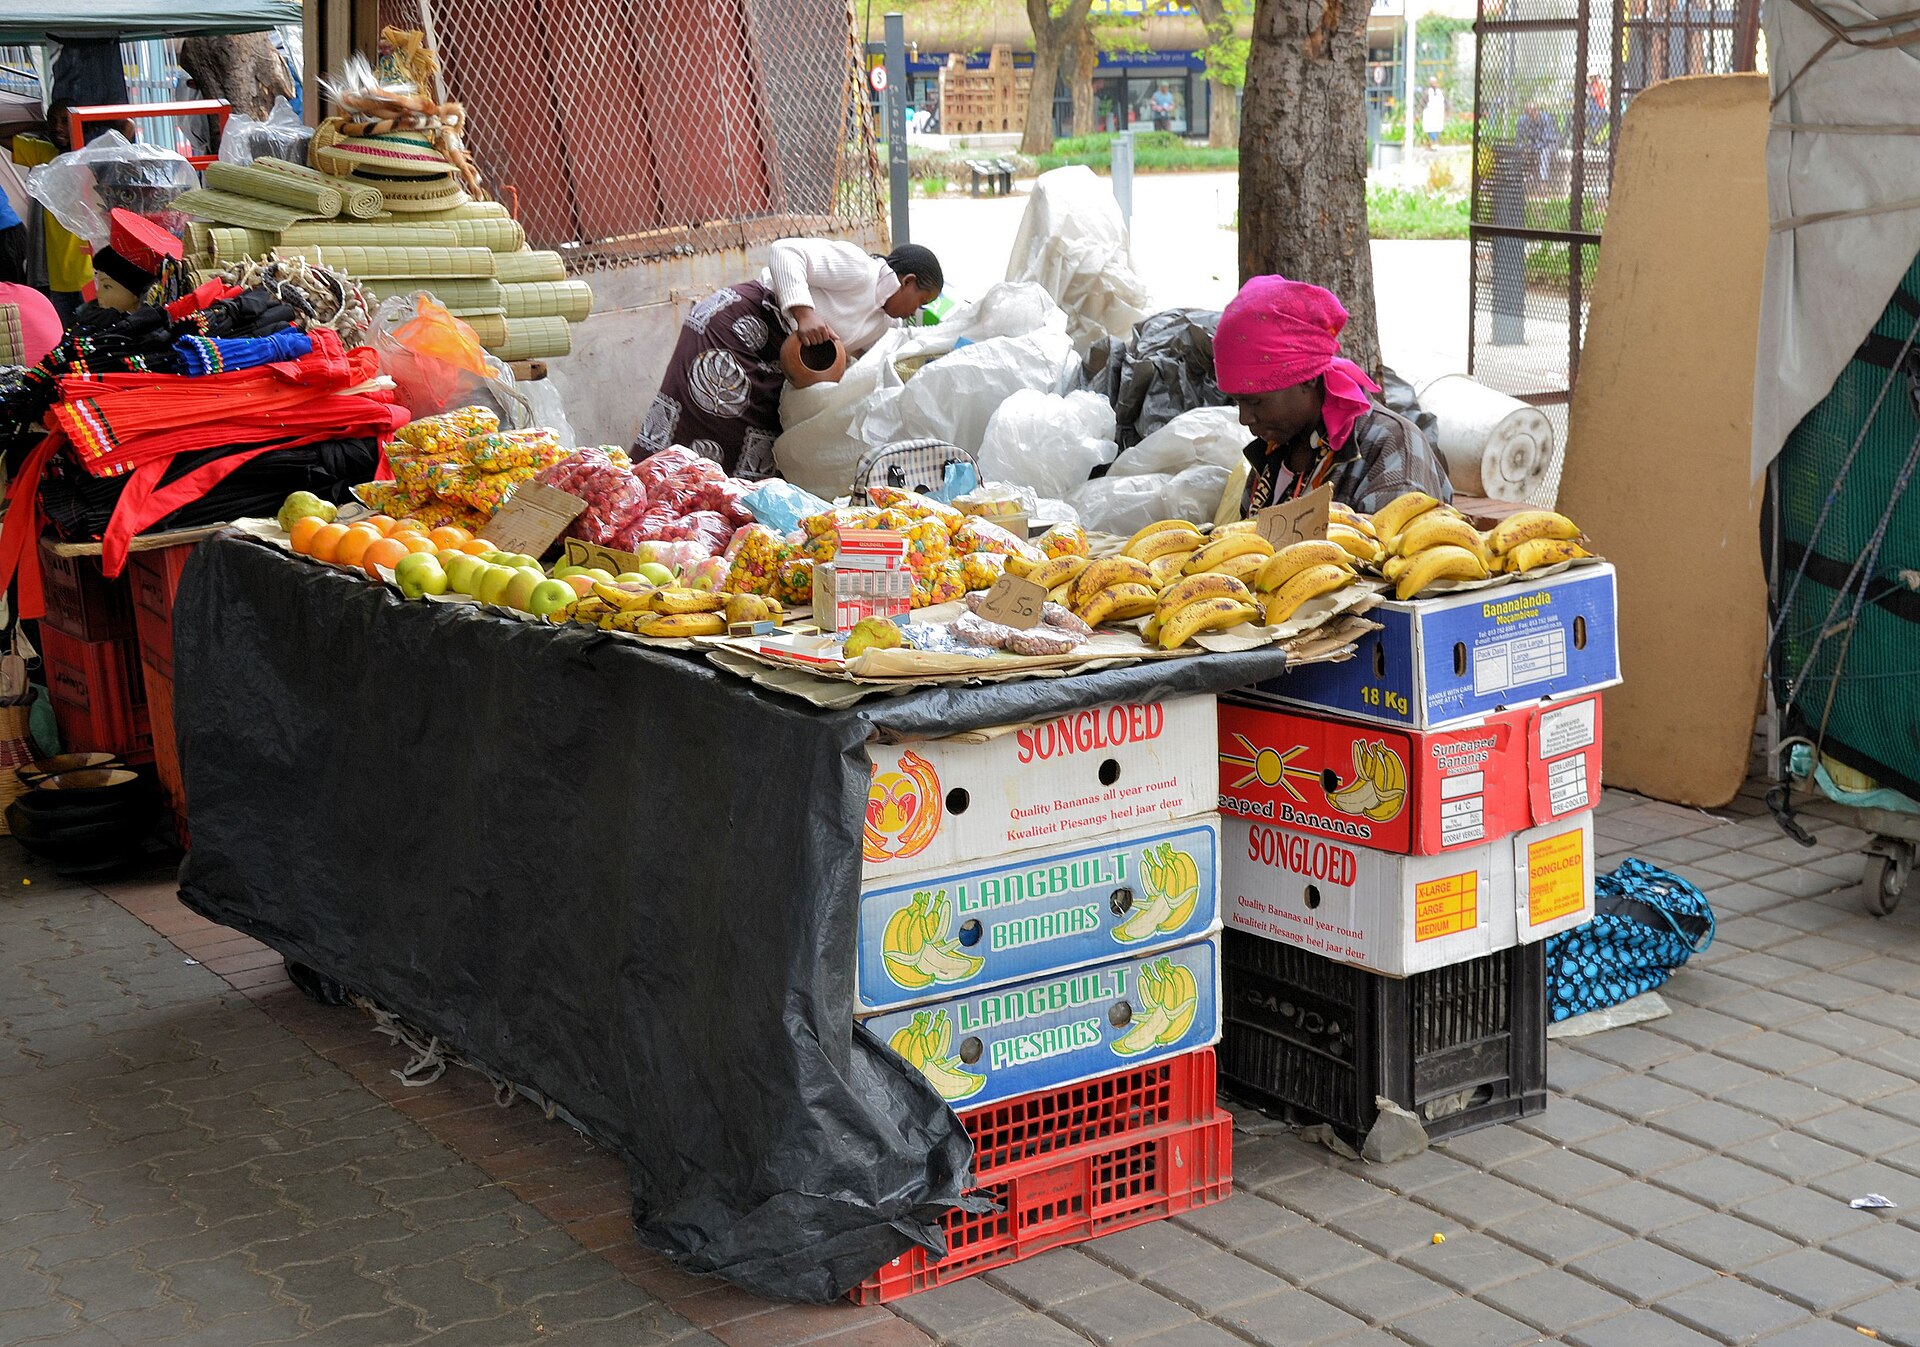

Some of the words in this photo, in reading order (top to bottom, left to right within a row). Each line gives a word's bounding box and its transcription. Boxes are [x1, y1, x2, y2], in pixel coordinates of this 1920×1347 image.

[1483, 591, 1552, 618] Bananalandia
[1513, 652, 1529, 662] Large
[1528, 638, 1544, 647] Large
[1360, 686, 1380, 706] 18
[1384, 690, 1408, 715] Kg
[1015, 703, 1164, 764] SONGLOED
[1432, 735, 1497, 757] Sunreaped
[1439, 751, 1488, 769] Bananas
[1010, 803, 1050, 820] Quality
[1053, 795, 1100, 811] Bananas
[1103, 788, 1116, 801] all
[1119, 785, 1143, 800] year
[1145, 776, 1177, 792] round
[1007, 823, 1057, 841] Kwaliteit
[1060, 813, 1107, 831] Piesangs
[1110, 805, 1133, 820] heel
[1135, 802, 1157, 816] jaar
[1159, 797, 1183, 810] deur
[1280, 803, 1372, 839] Bananas
[1248, 824, 1357, 887] SONGLOED
[1530, 854, 1581, 879] SONGLOED
[958, 854, 1131, 912] LANGBULT
[1418, 882, 1452, 899] X-LARGE
[992, 904, 1100, 951] BANANAS
[1238, 895, 1266, 913] Quality
[1268, 905, 1301, 922] Bananas
[1303, 916, 1314, 927] all
[1316, 920, 1334, 932] year
[1337, 926, 1363, 940] round
[1418, 904, 1445, 918] LARGE
[1418, 920, 1450, 936] MEDIUM
[1232, 912, 1267, 931] Kwaliteit
[1269, 924, 1304, 942] Piesangs
[1306, 935, 1324, 948] heel
[1325, 940, 1343, 954] jaar
[1345, 947, 1366, 960] deur
[959, 968, 1131, 1031] LANGBULT
[991, 1019, 1101, 1069] PIESANGS
